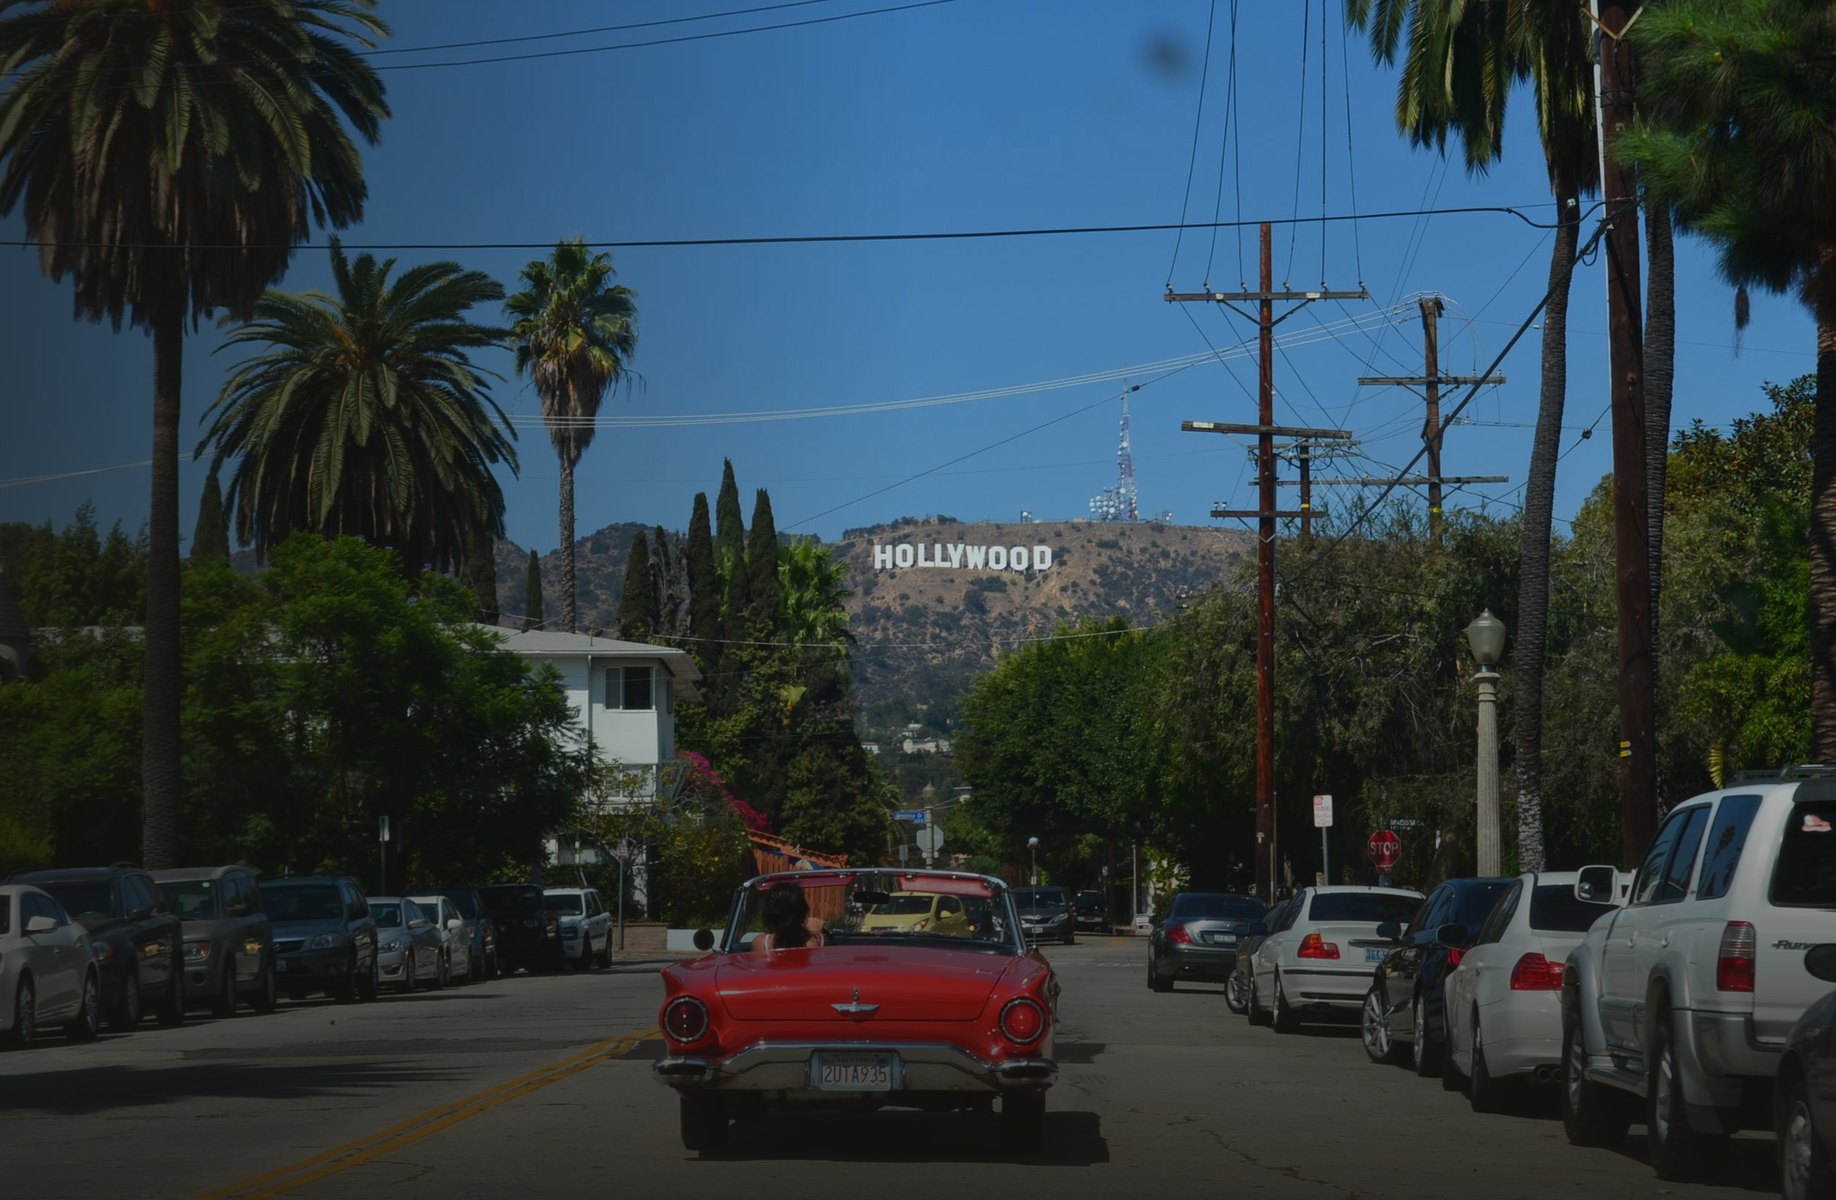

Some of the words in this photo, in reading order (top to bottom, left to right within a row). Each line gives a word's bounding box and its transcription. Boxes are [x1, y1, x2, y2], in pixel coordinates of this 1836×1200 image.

[874, 543, 1053, 572] HOLLYWOOD
[1370, 841, 1399, 856] STOP
[824, 1065, 887, 1083] 2UTA935
